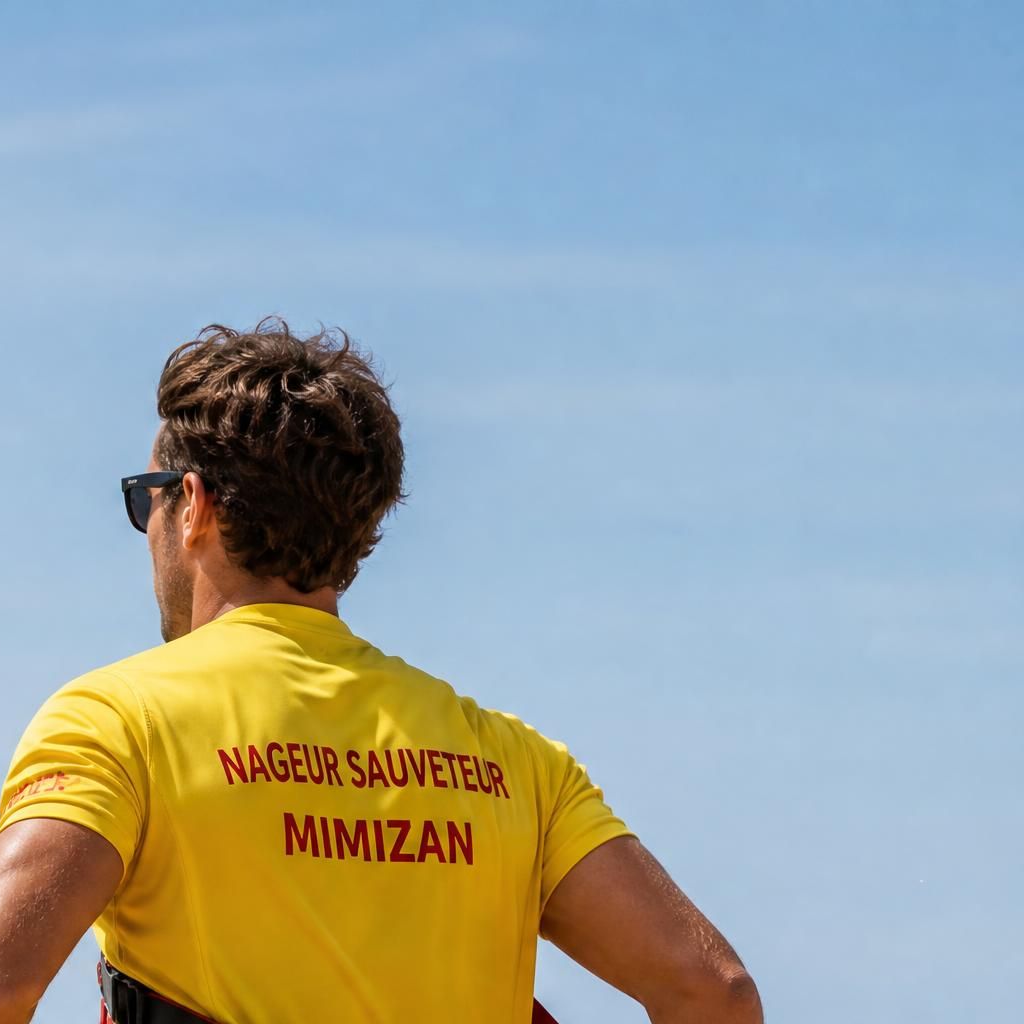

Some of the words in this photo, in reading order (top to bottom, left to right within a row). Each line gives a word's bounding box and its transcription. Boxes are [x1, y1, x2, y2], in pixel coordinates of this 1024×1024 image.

[217, 741, 344, 787] NAGEUR
[346, 748, 510, 799] SAUVETEUR
[283, 812, 474, 865] MIMIZAN
